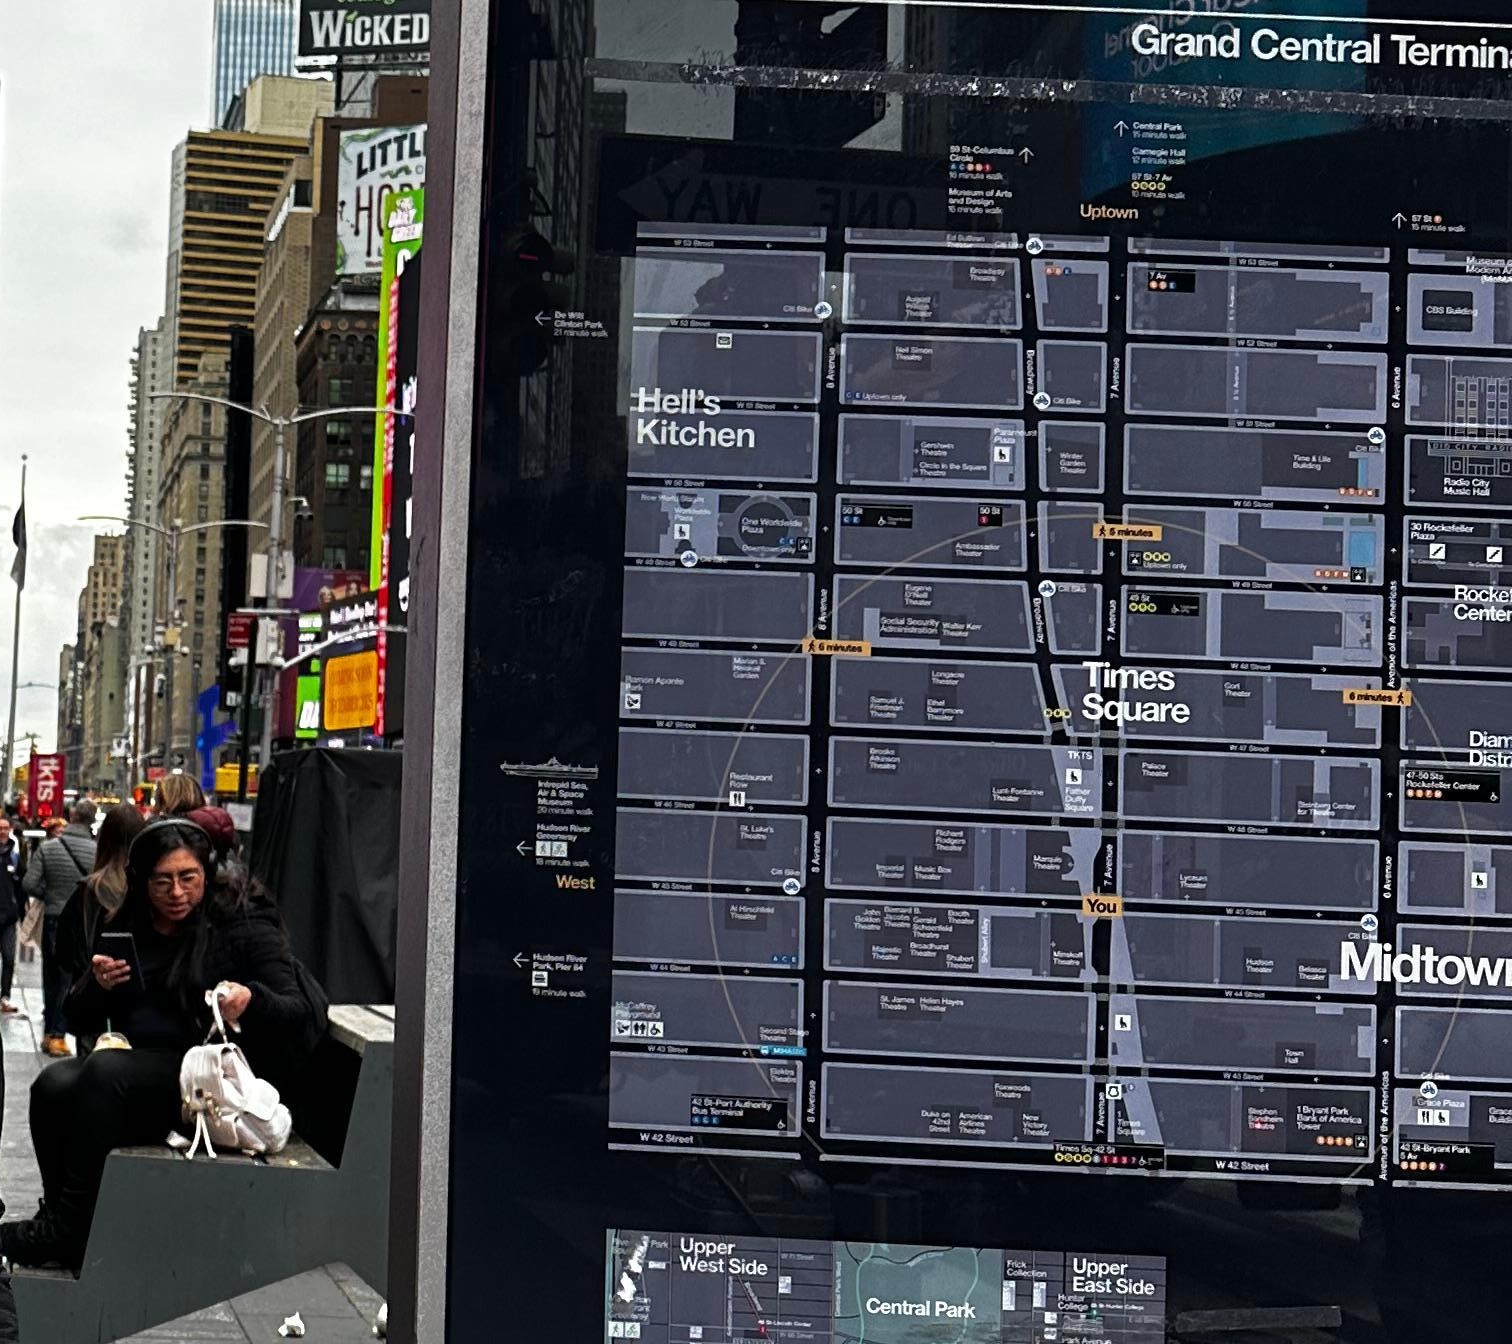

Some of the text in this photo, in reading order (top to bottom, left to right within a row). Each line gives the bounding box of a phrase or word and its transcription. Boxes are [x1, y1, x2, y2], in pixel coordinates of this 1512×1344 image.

[1131, 23, 1241, 59] Grand
[1251, 28, 1381, 65] Central
[1390, 33, 1512, 69] Termin
[356, 131, 426, 180] LITTL
[1080, 203, 1139, 221] Uptown
[638, 386, 721, 416] Hell's
[637, 418, 756, 449] Kitchen
[1117, 528, 1153, 537] minutes
[1387, 579, 1398, 624] Americas
[1453, 603, 1512, 622] Center
[1082, 661, 1176, 692] Times
[1387, 654, 1397, 689] Avenue
[1357, 693, 1393, 703] minutes
[1082, 693, 1191, 727] Square
[1067, 750, 1093, 761] TKTS
[36, 758, 61, 802] tkts
[556, 874, 596, 890] West
[1087, 899, 1117, 914] You
[1340, 940, 1512, 987] Midtow
[652, 1133, 666, 1144] 42
[667, 1134, 694, 1145] Street
[680, 1237, 736, 1256] Upper
[679, 1256, 768, 1275] West Side
[1072, 1257, 1128, 1276] Upper
[1072, 1277, 1155, 1295] East Side
[866, 1297, 976, 1319] Central Park
